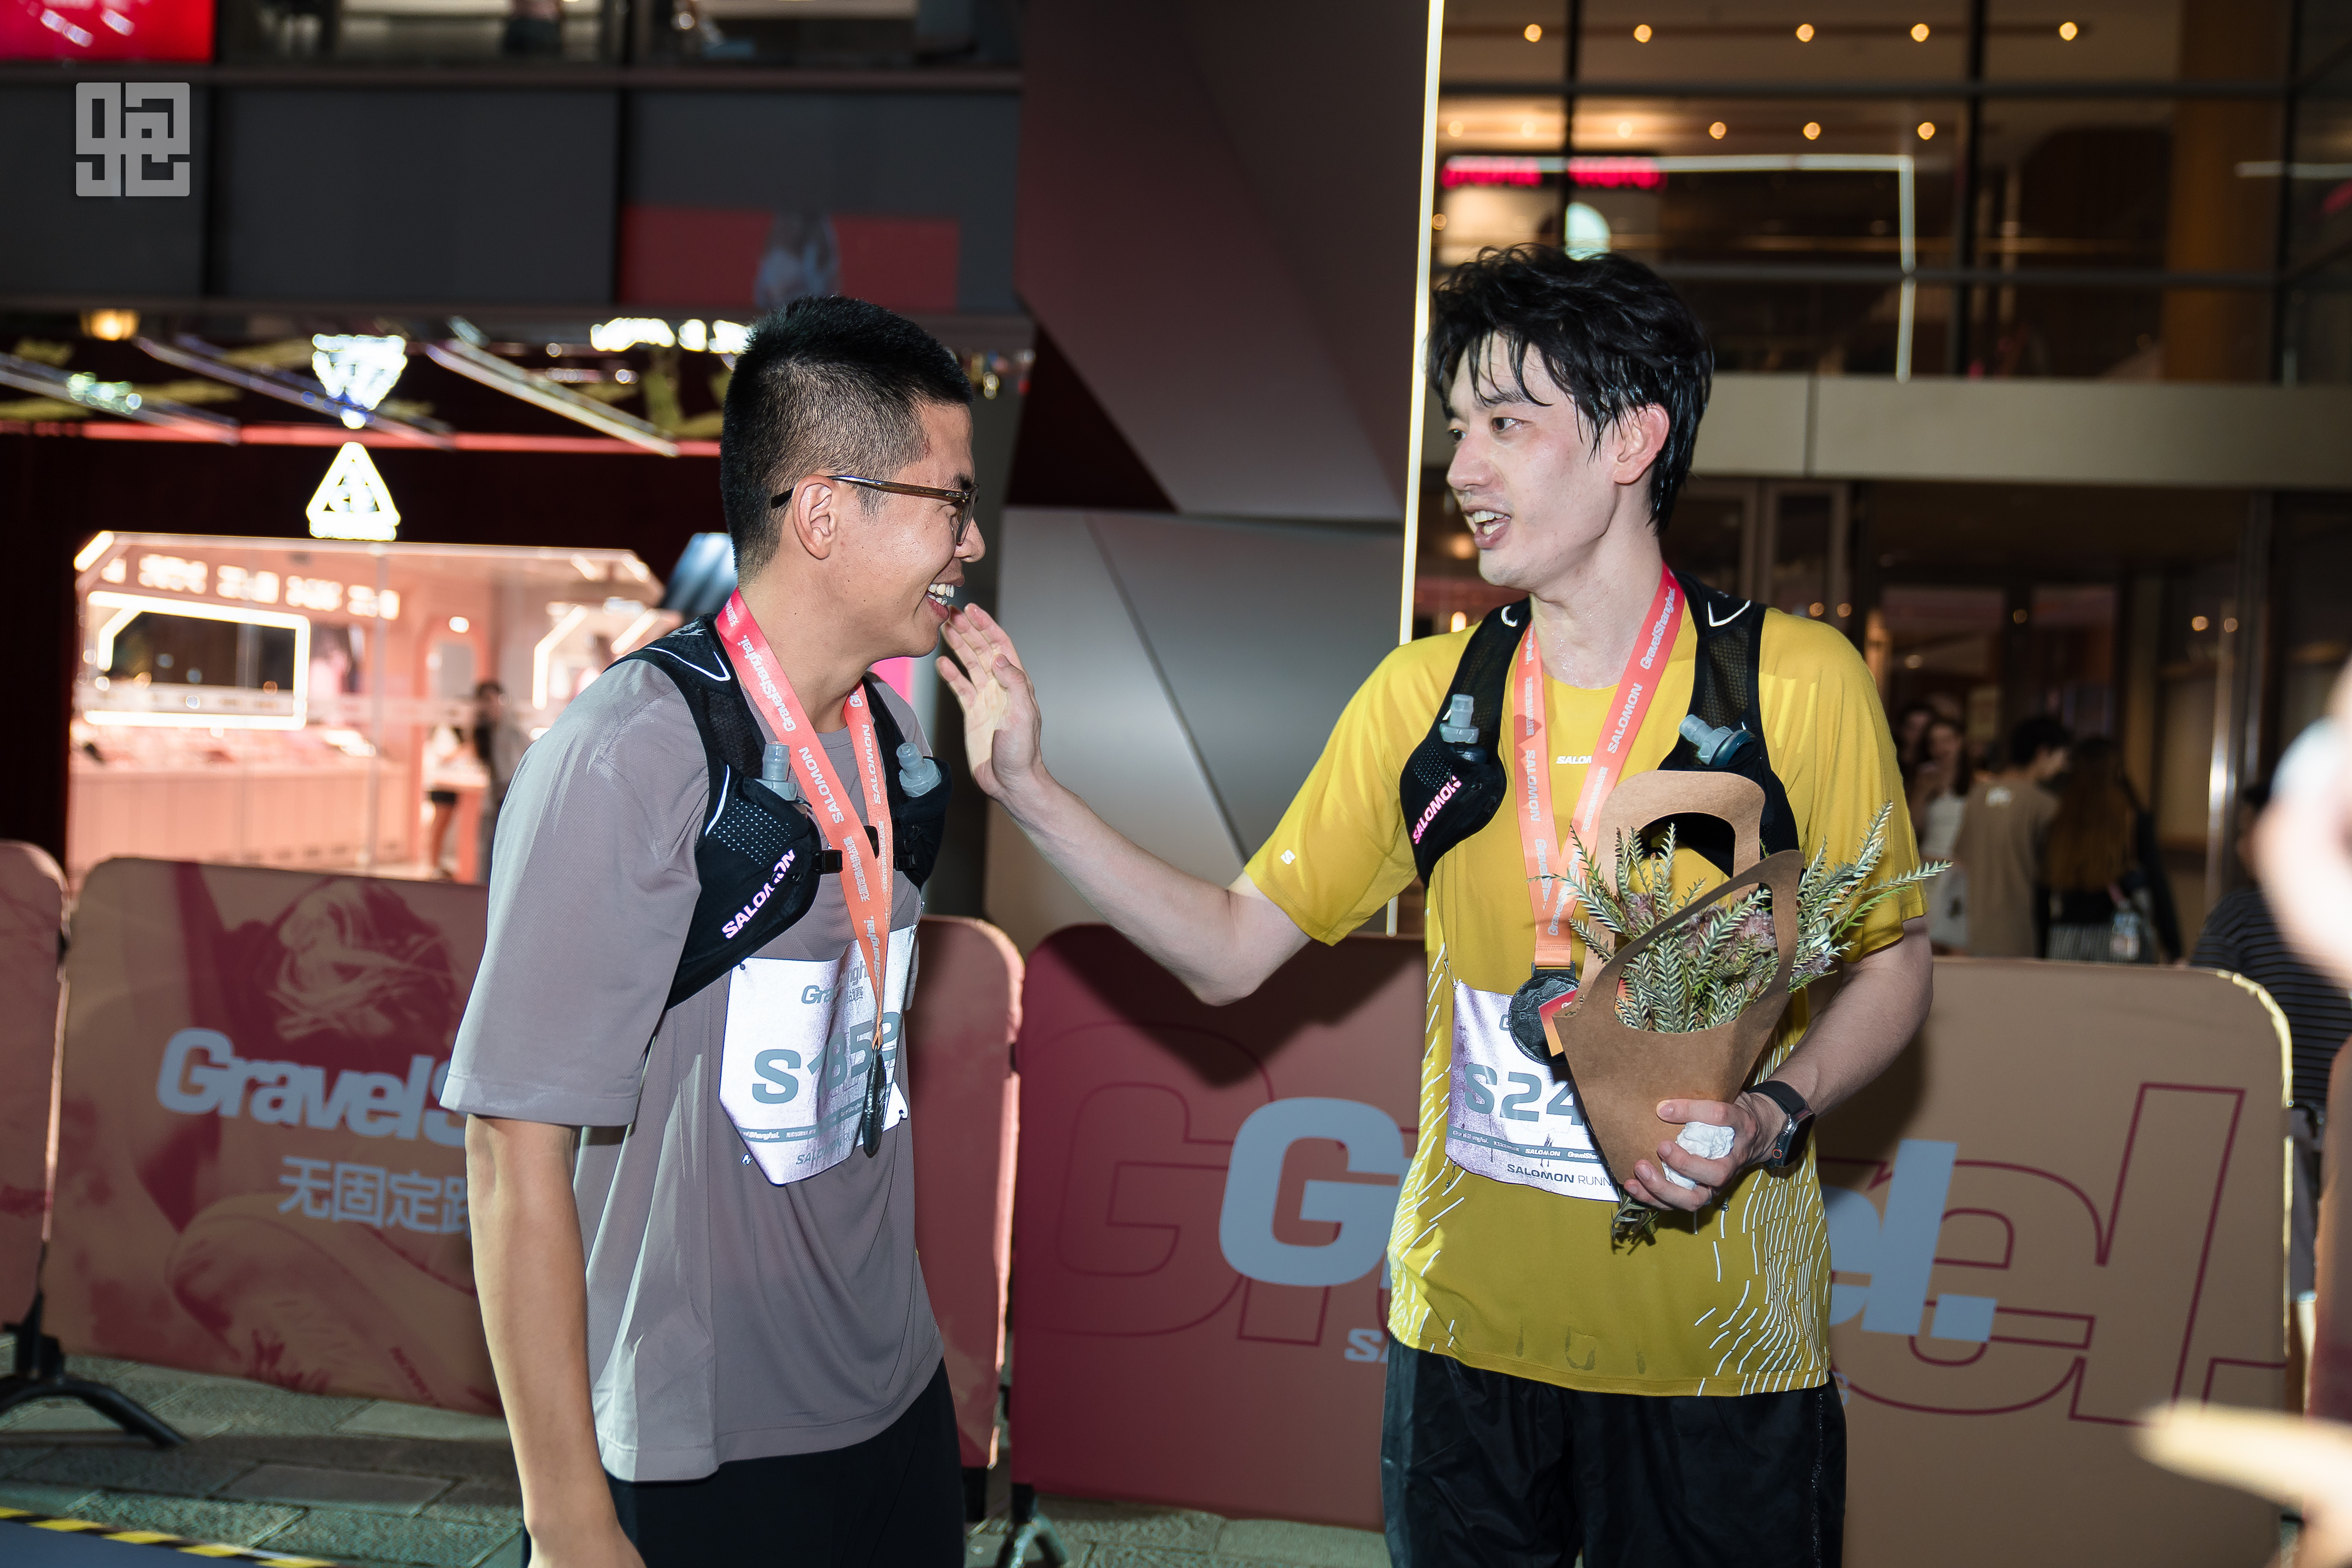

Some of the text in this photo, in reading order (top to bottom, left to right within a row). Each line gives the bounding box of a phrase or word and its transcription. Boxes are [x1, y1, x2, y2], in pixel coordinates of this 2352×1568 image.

[737, 634, 797, 732] GravelShanghai.
[1607, 683, 1643, 754] SALOMON
[798, 747, 845, 824] SALOMON
[861, 724, 881, 805] SALOMON
[1526, 749, 1541, 822] SALOMON
[843, 835, 870, 903] 无固定路线挑战赛
[1507, 1164, 1612, 1187] SALOMON RUNN
[1525, 1148, 1561, 1157] SALOMON
